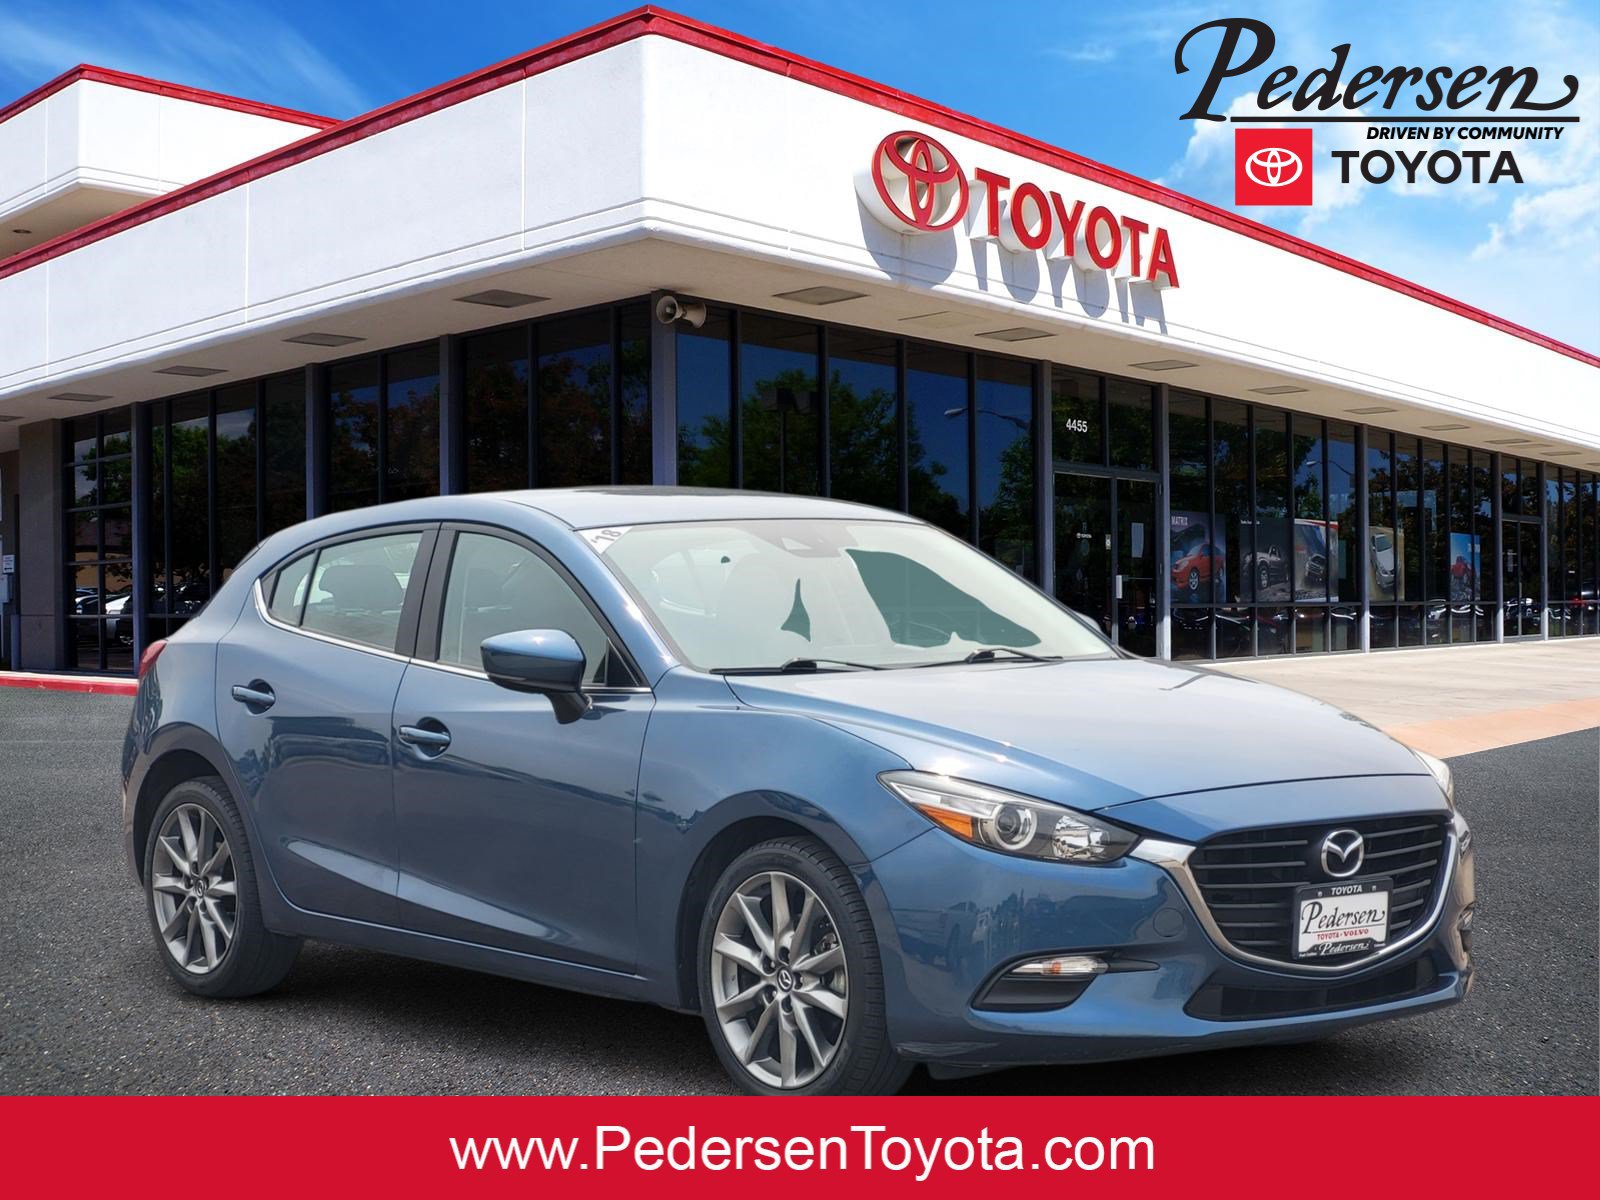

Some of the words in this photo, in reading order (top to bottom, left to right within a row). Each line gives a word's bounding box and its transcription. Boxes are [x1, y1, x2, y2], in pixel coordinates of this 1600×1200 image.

[975, 167, 1180, 288] TOYOTA
[1066, 418, 1088, 433] 4455
[1331, 885, 1363, 896] TOYOTA
[1302, 901, 1385, 935] Pedersen
[1317, 932, 1340, 941] TOYOTA
[1343, 929, 1369, 937] VOLVO
[1319, 943, 1369, 955] Pedersen
